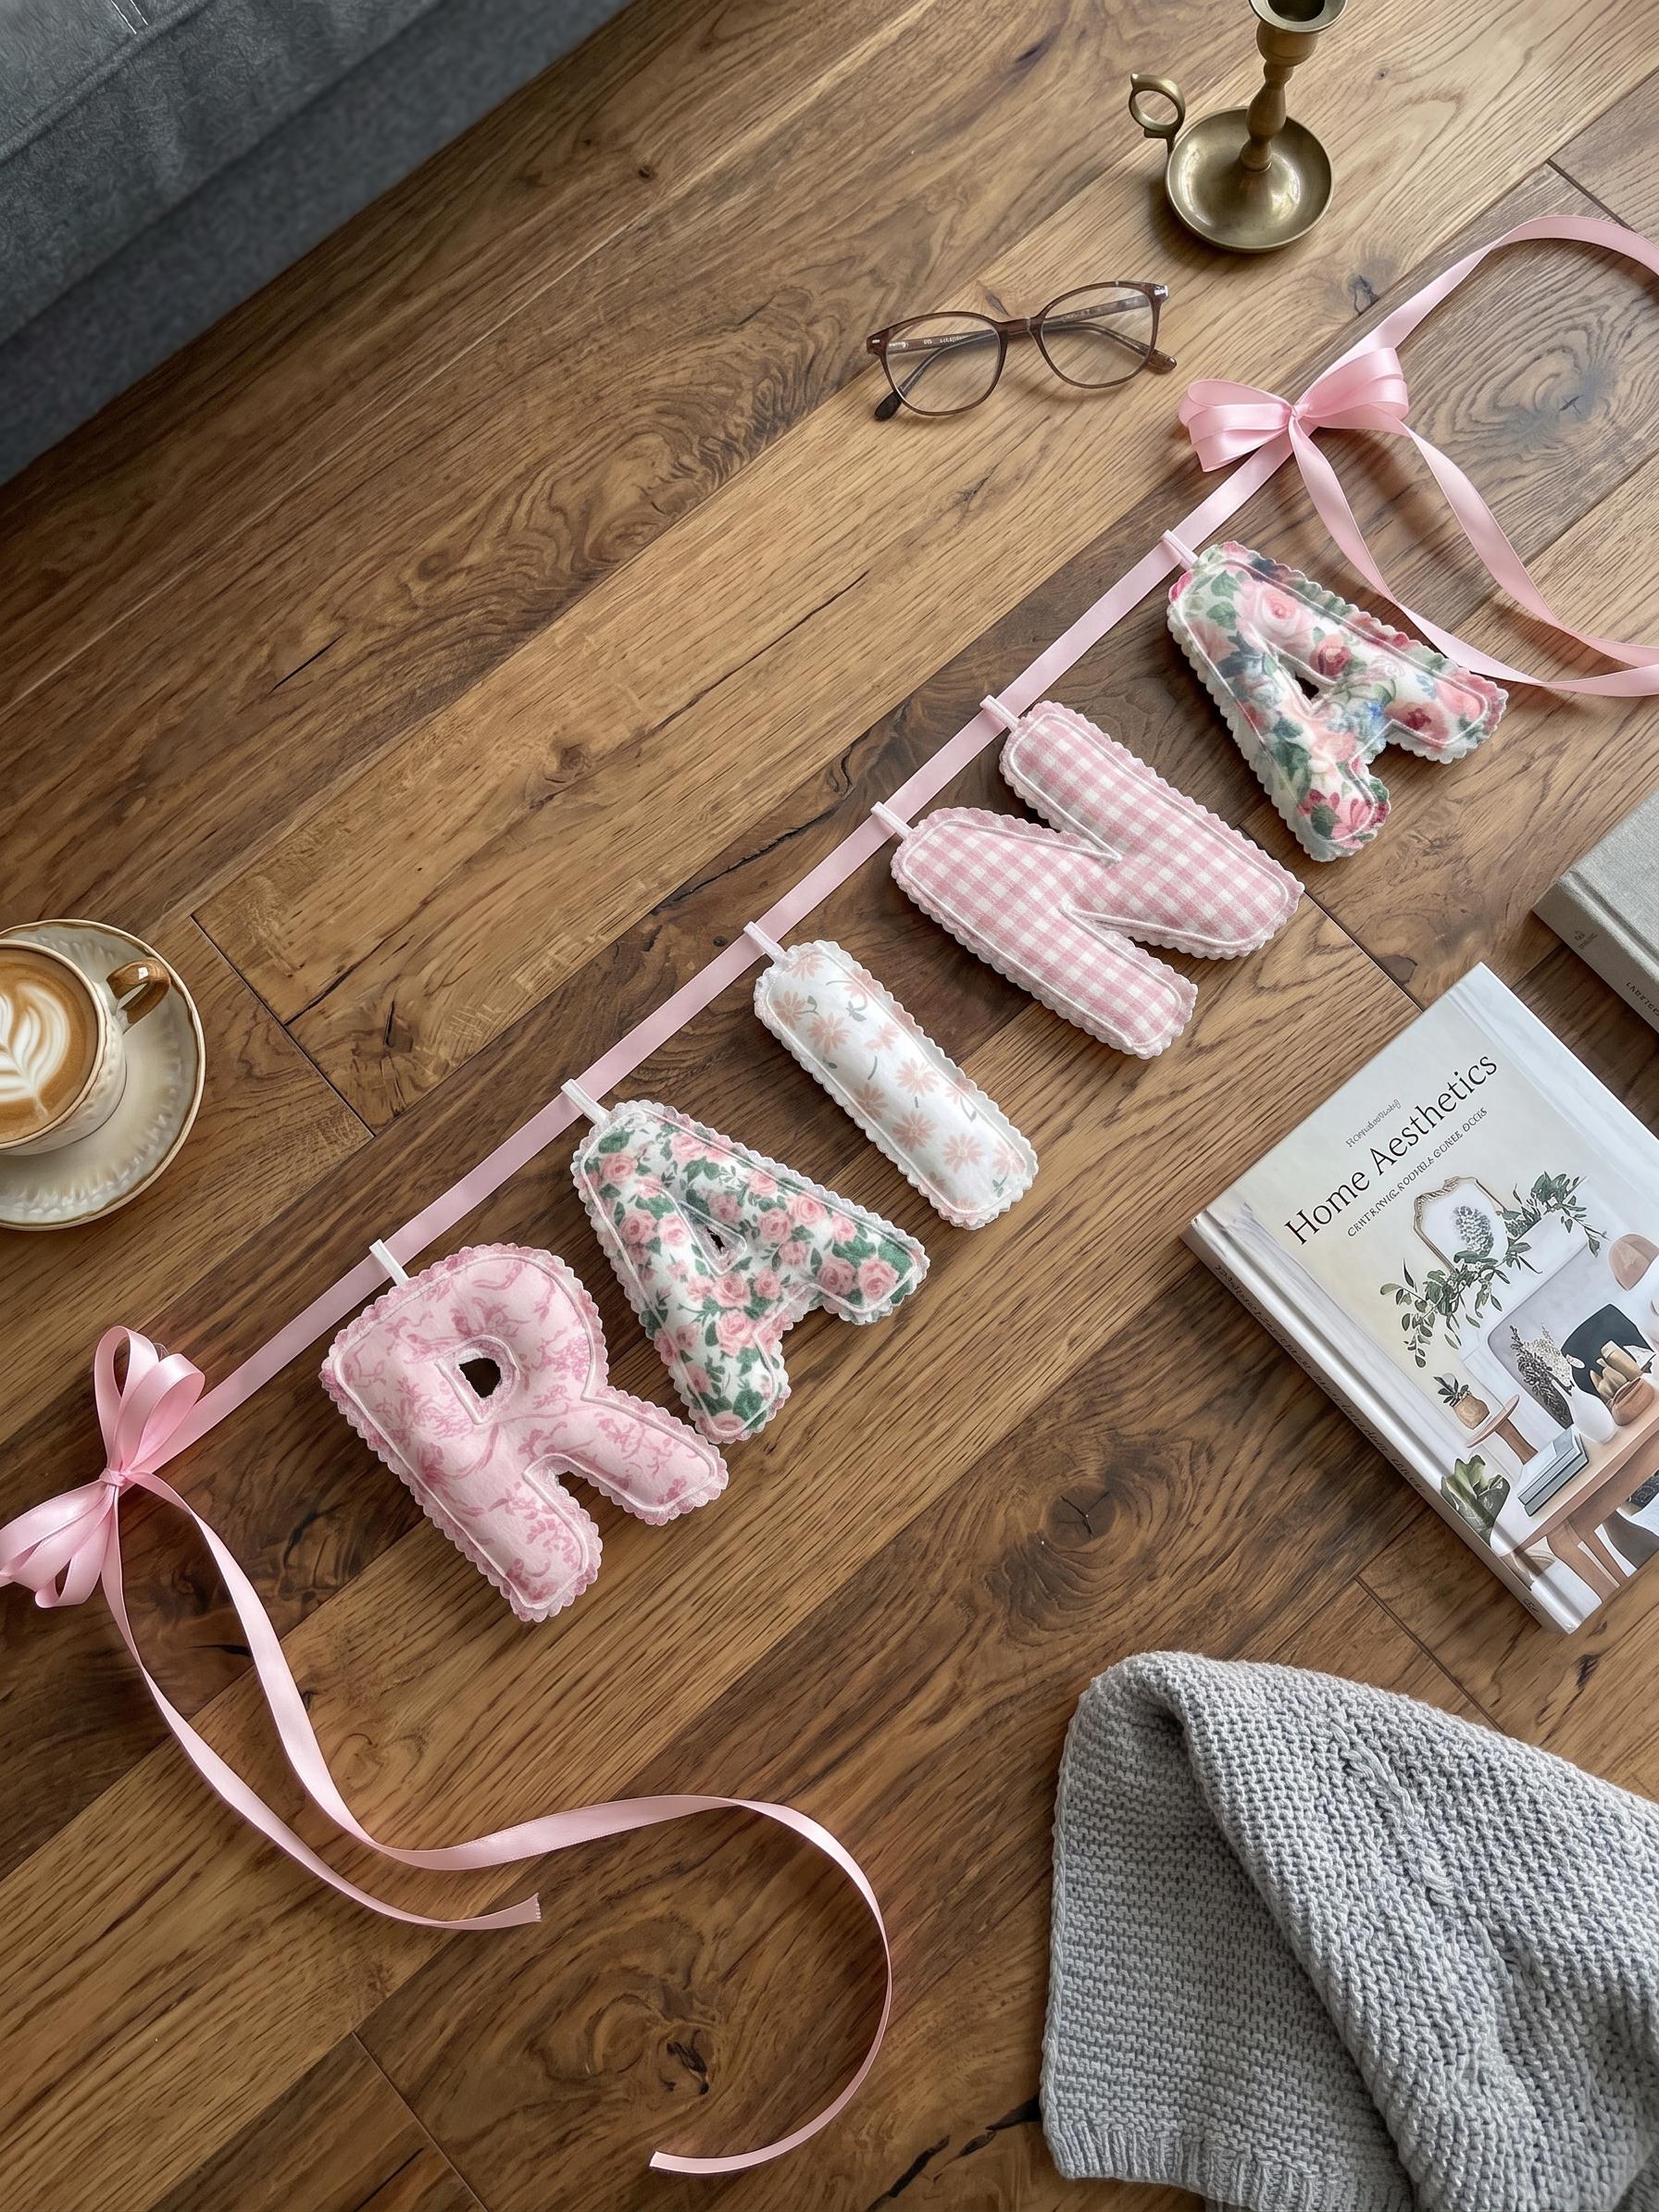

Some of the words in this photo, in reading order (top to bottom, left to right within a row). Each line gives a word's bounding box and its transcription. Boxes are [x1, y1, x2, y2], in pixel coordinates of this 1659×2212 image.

[321, 541, 1509, 1623] RAINA
[1284, 1171, 1370, 1245] Home
[1370, 1056, 1498, 1176] Aesthetics
